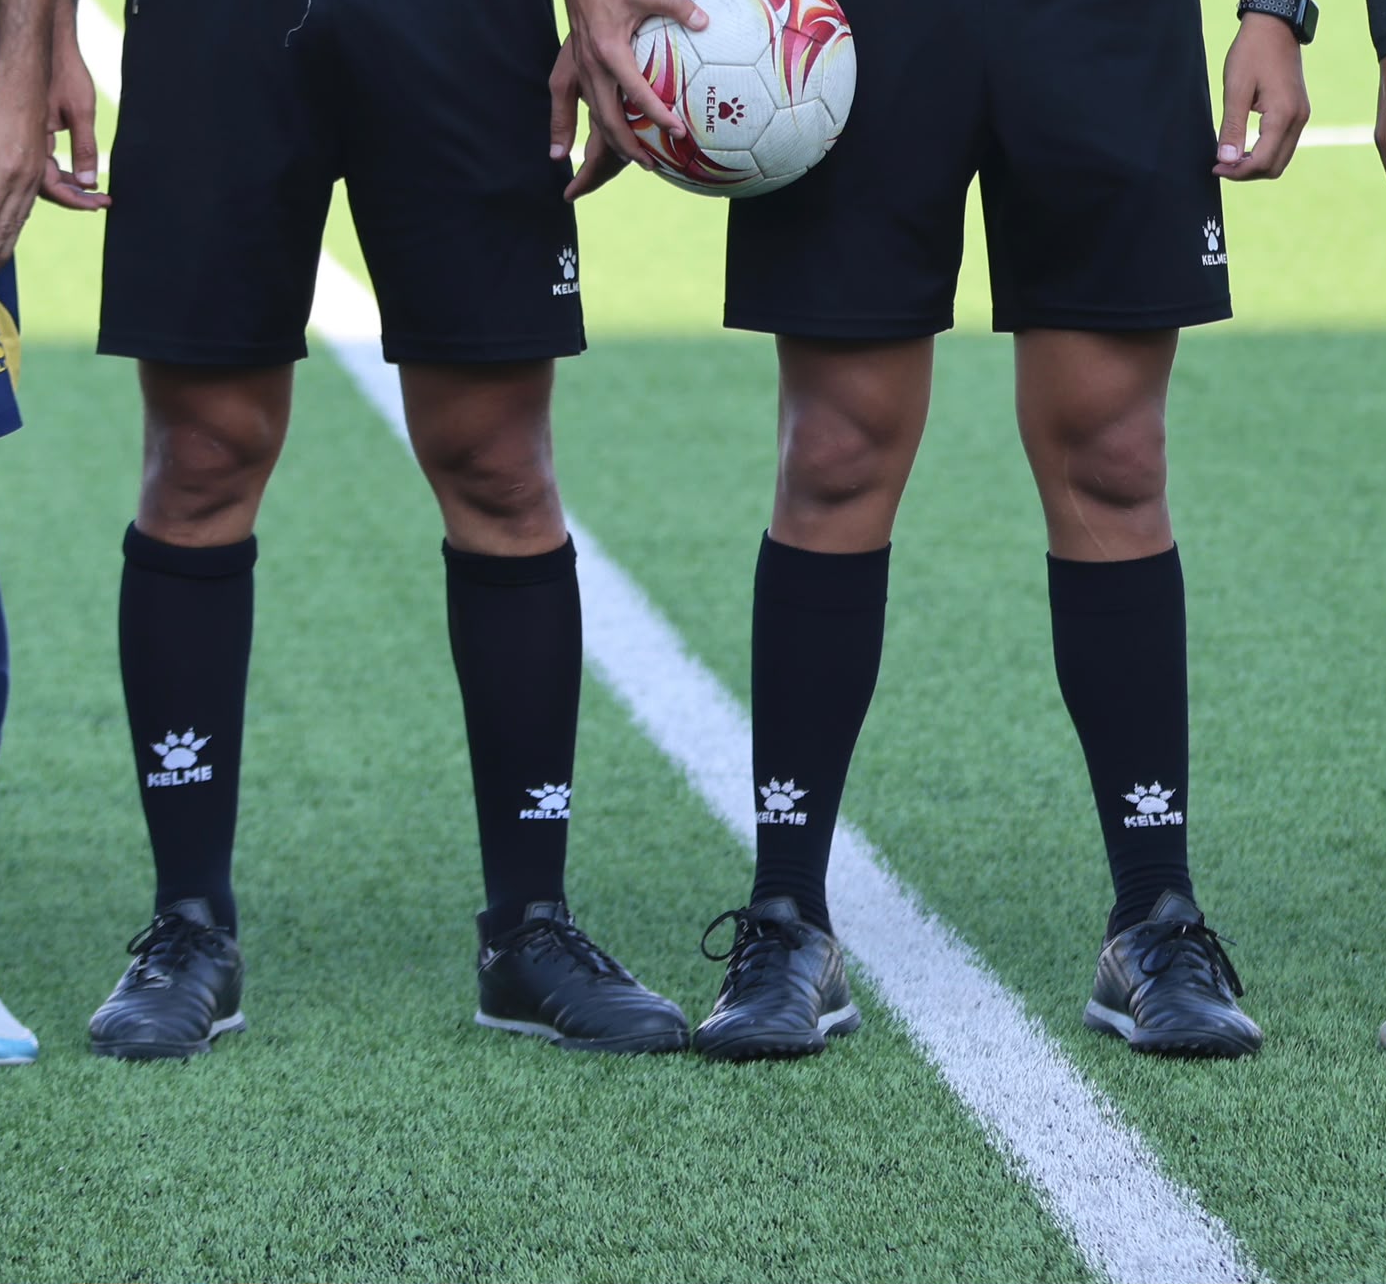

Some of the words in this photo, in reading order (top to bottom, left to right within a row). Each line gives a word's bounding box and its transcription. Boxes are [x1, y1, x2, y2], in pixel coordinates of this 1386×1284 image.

[706, 86, 716, 133] KELME
[1201, 253, 1227, 267] KELME
[147, 765, 213, 787] KELME
[519, 809, 571, 819] KELM
[1124, 811, 1183, 828] KELME
